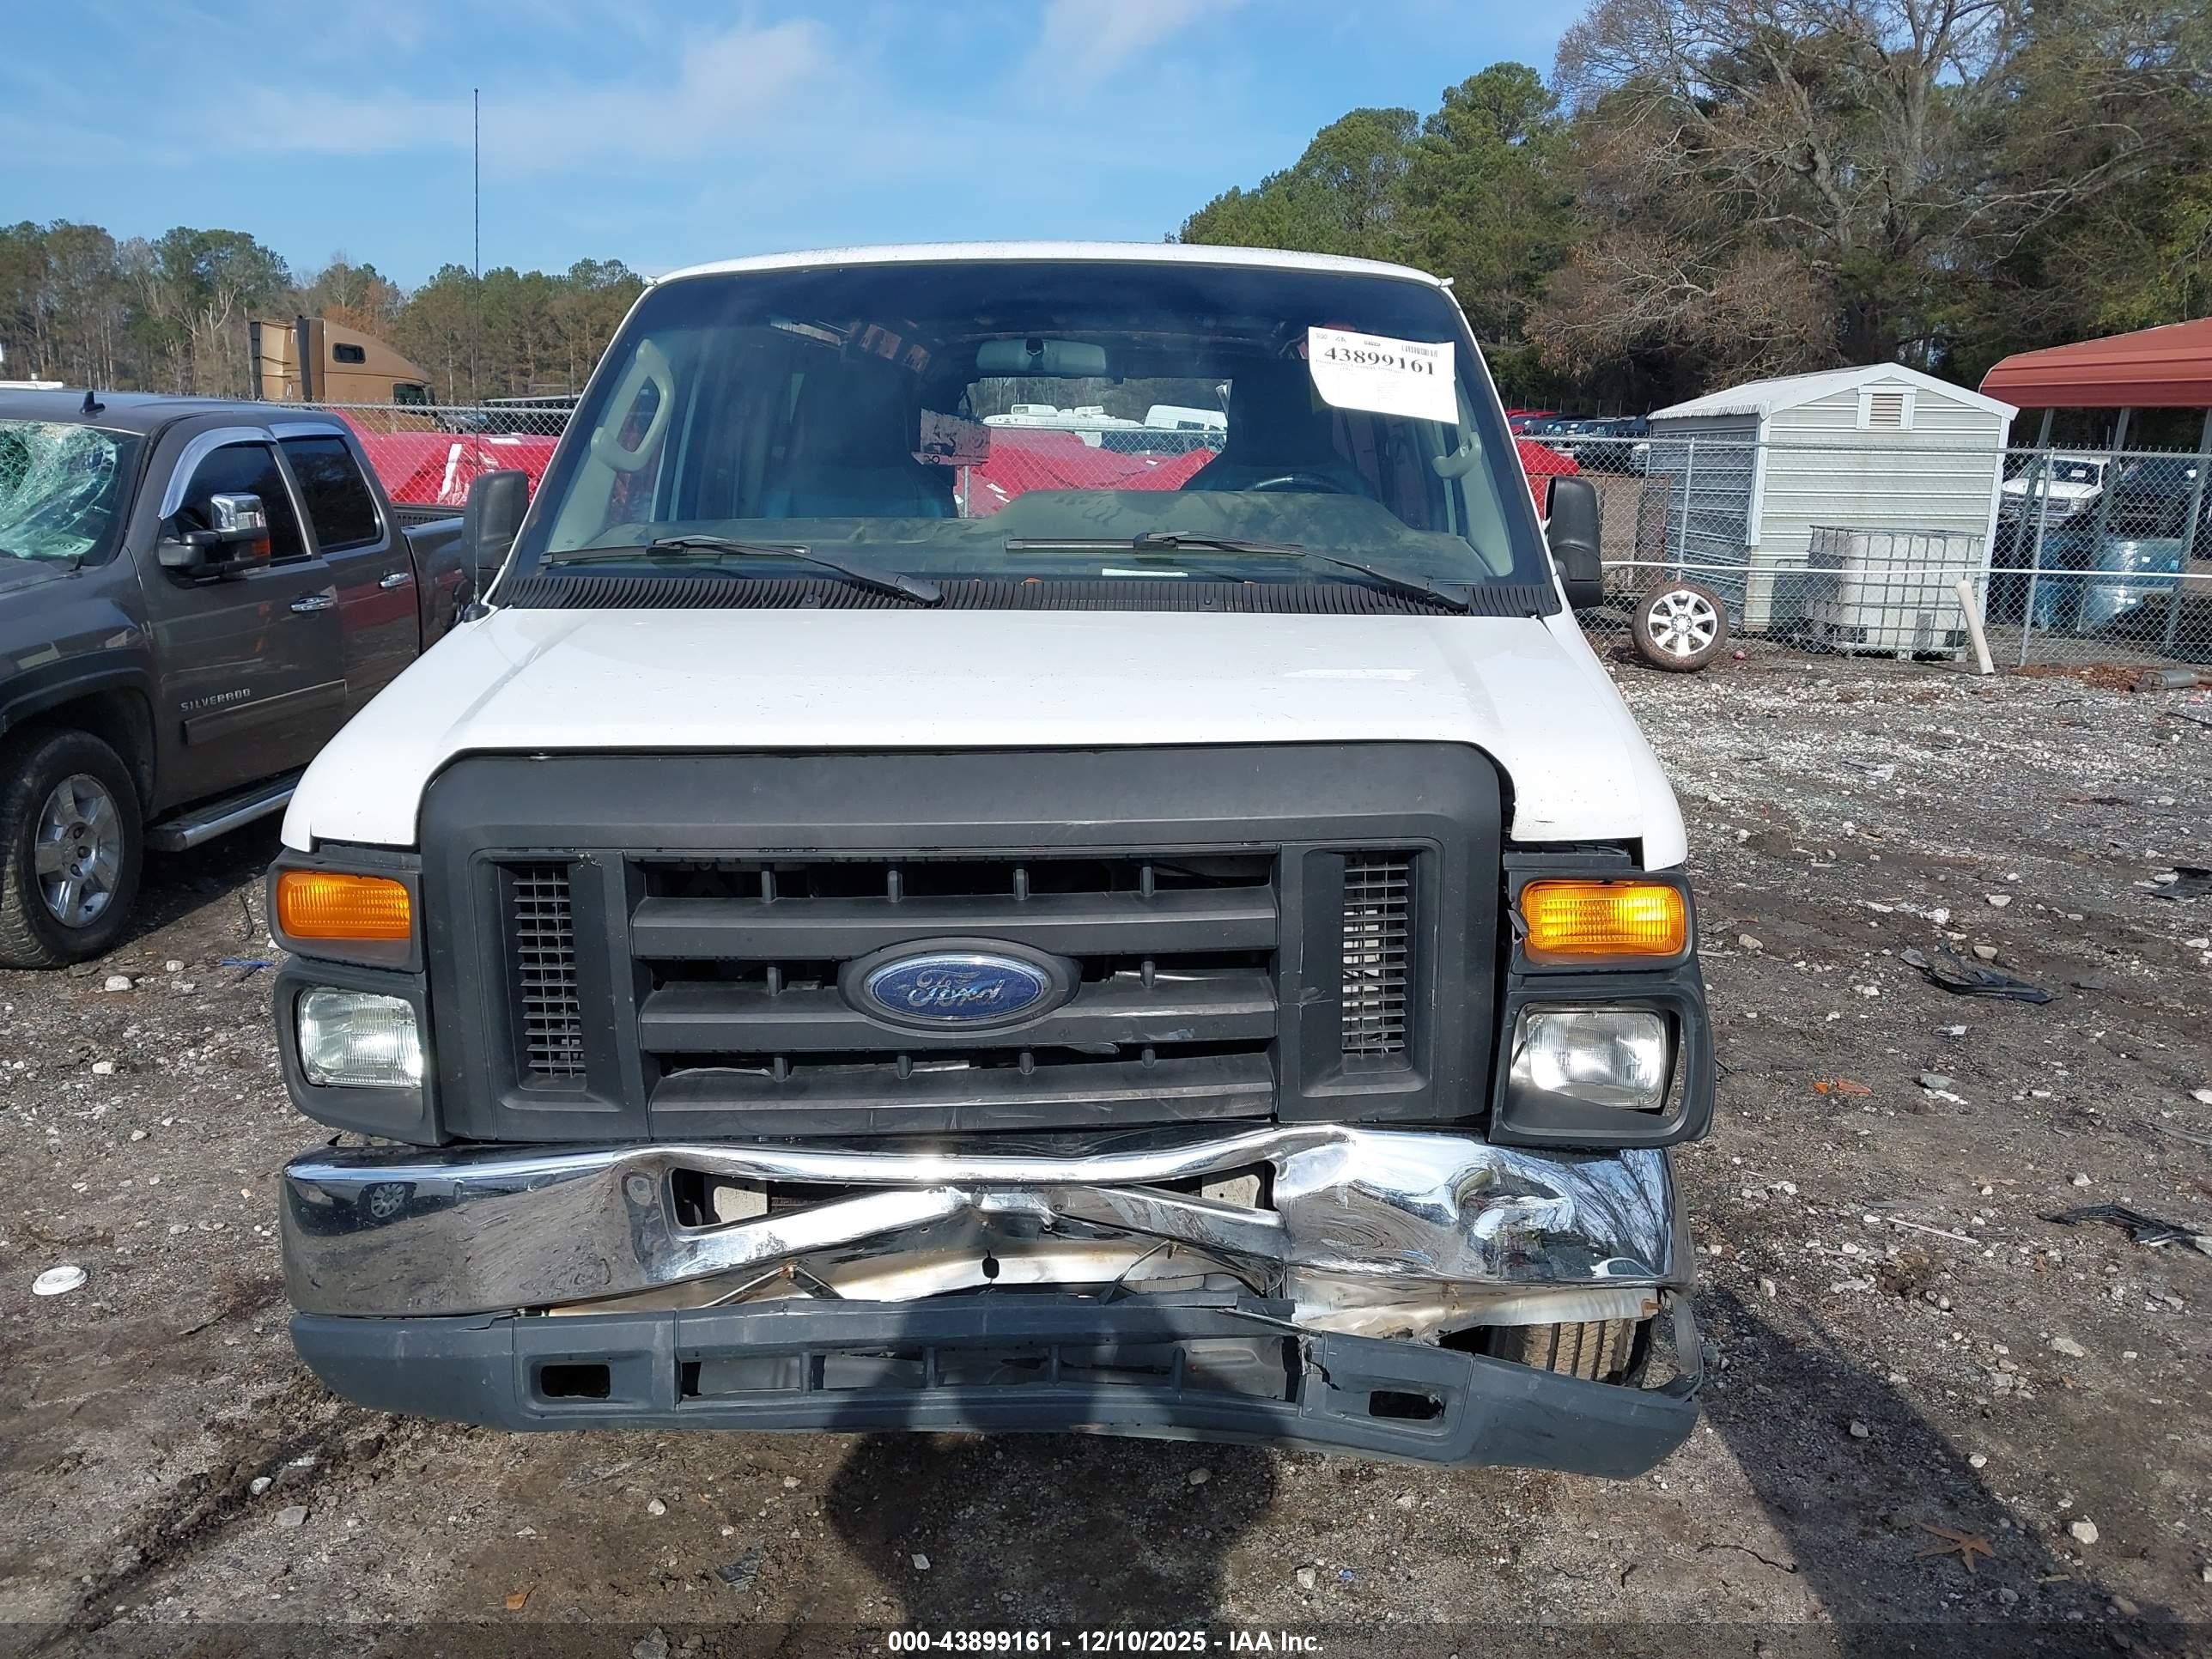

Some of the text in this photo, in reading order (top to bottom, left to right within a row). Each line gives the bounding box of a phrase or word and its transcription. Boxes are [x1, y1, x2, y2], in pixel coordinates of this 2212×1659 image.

[1324, 347, 1435, 375] 43899161
[180, 688, 251, 712] SILVERADO
[906, 969, 1006, 1007] Ford
